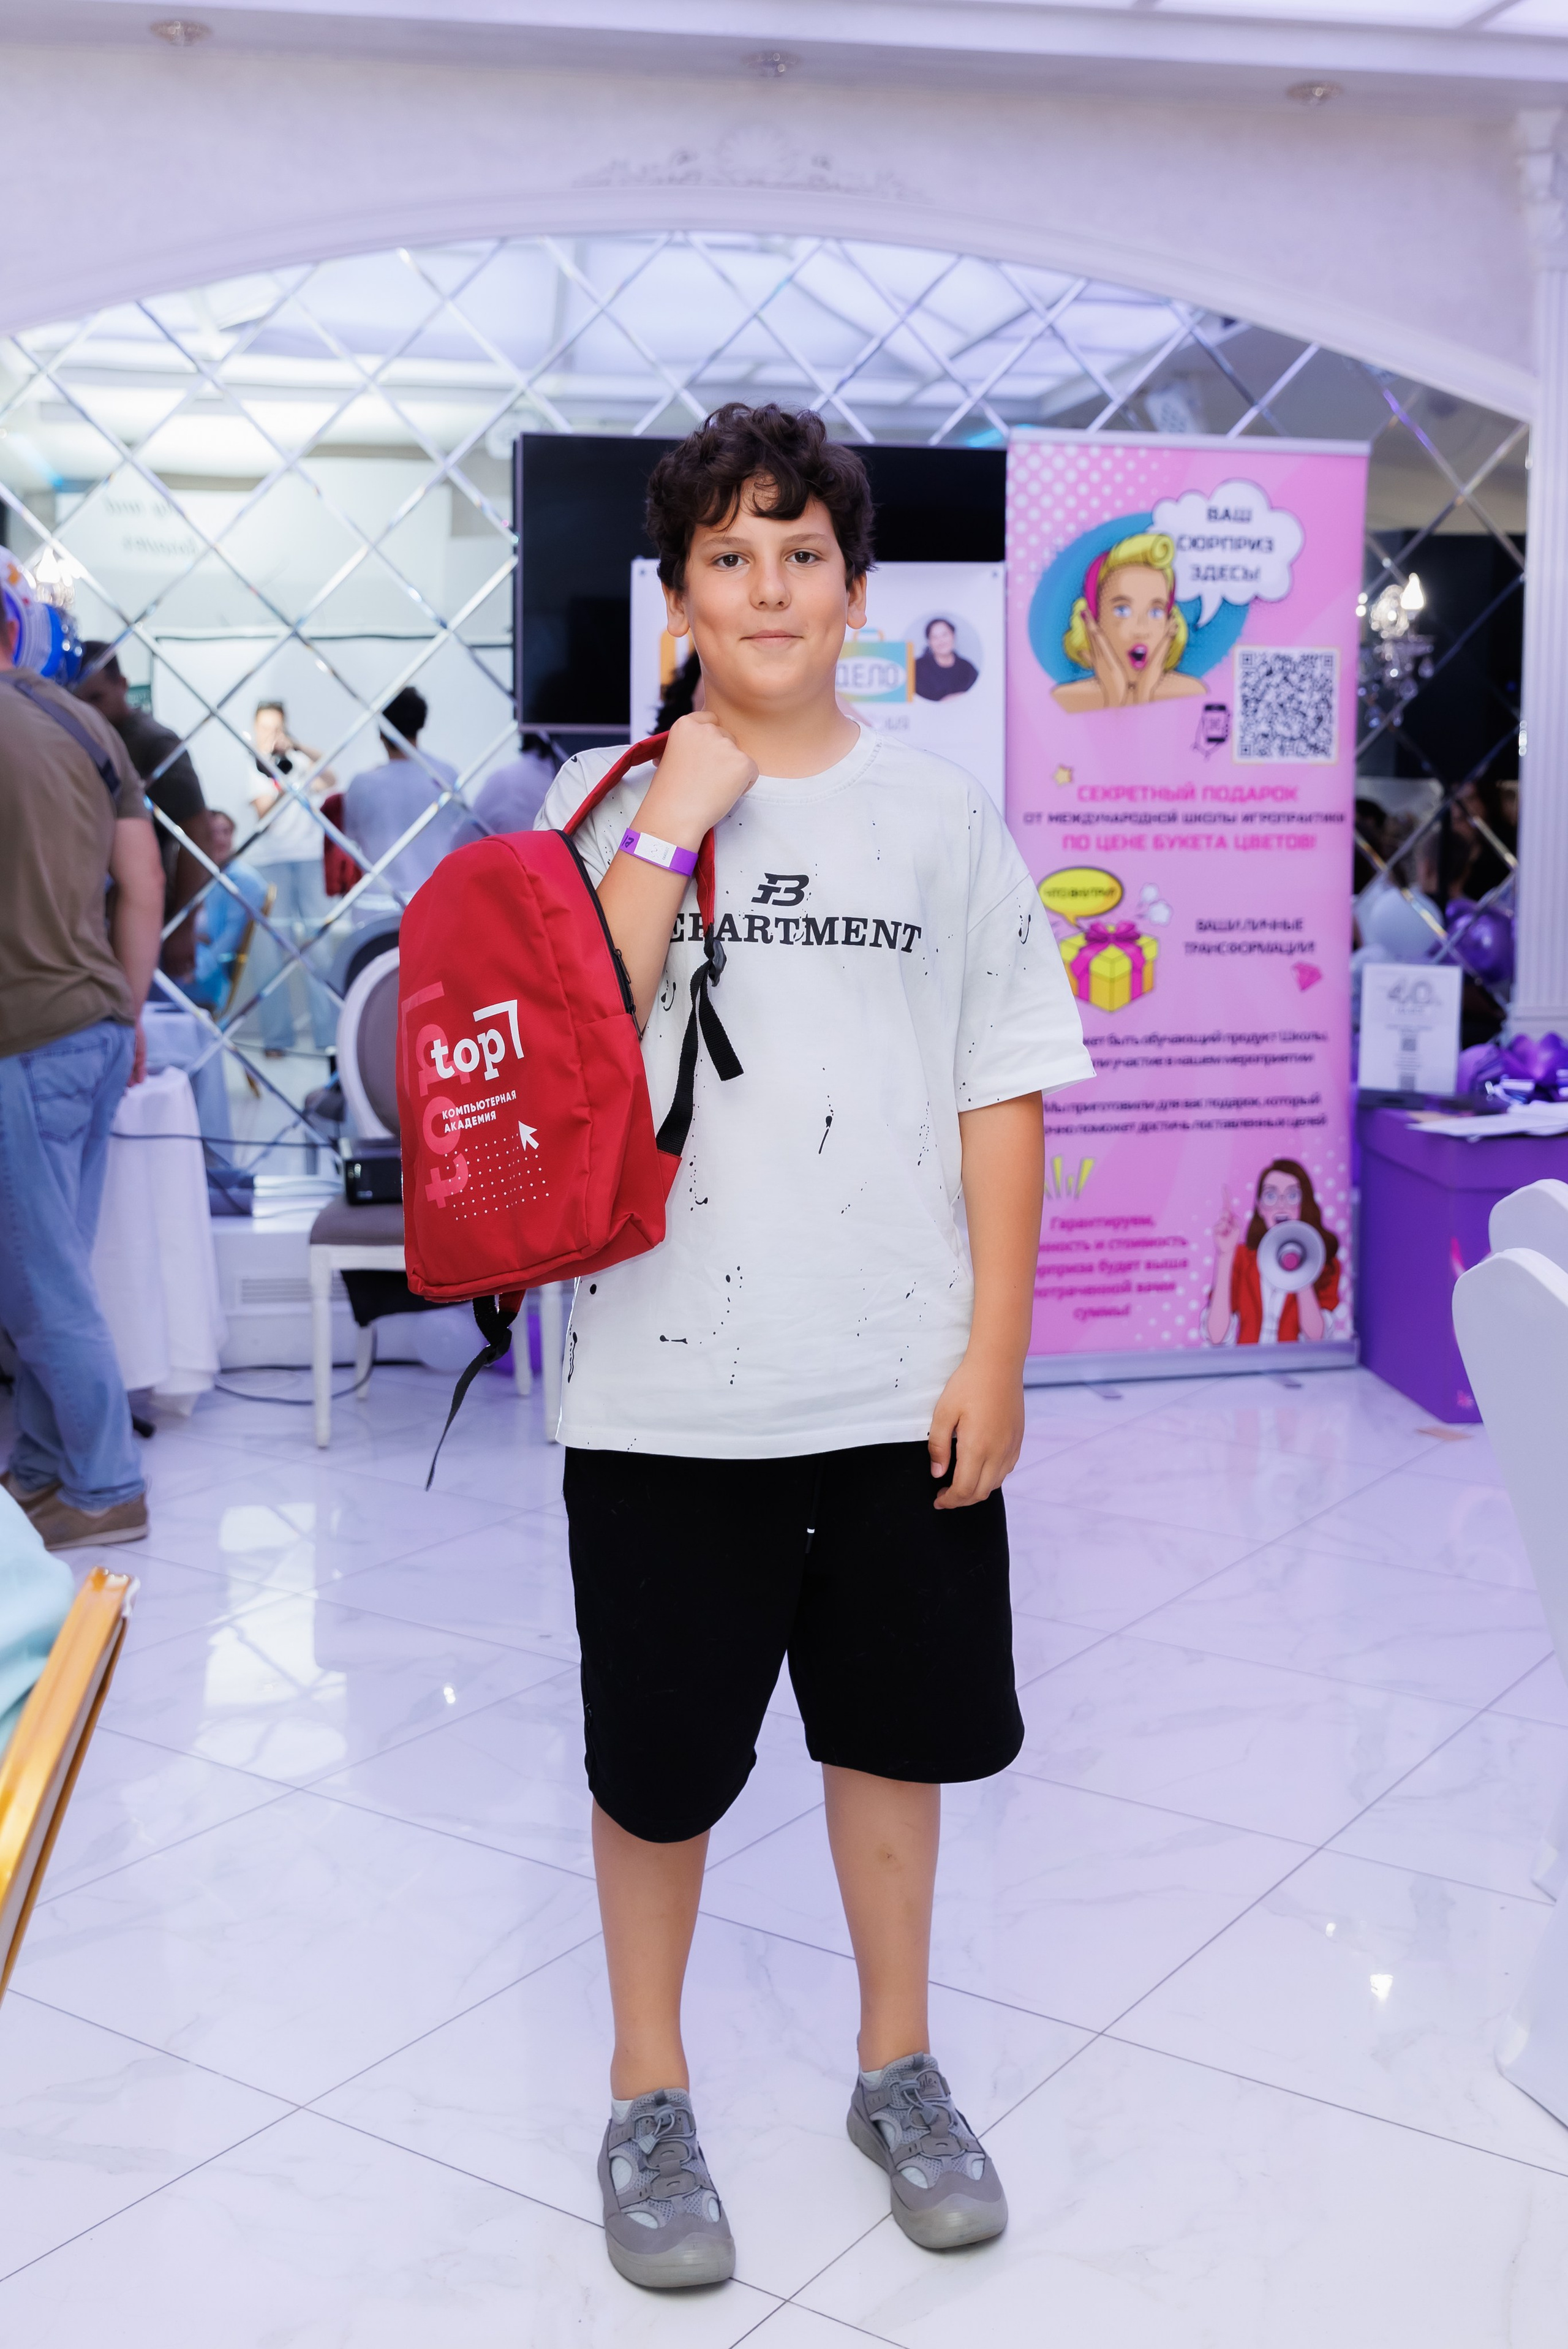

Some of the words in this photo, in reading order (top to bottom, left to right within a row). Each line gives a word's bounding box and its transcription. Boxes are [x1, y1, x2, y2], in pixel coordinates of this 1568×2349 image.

[1207, 508, 1251, 522] ВАШ
[1177, 535, 1273, 552] СЮРПРИЗ
[1077, 782, 1196, 802] СЕКРЕТНЫЙ
[1202, 785, 1298, 804] ПОДАРОК
[1062, 834, 1091, 850] ПО
[1096, 834, 1146, 853] ЦЕНЕ
[1152, 834, 1227, 850] БУКЕТА
[670, 912, 922, 953] EPARTMENT
[431, 1028, 505, 1081] top
[442, 1090, 516, 1120] КОМПЬЮТЕРНАЯ
[444, 1110, 497, 1133] АКАДЕМИЯ
